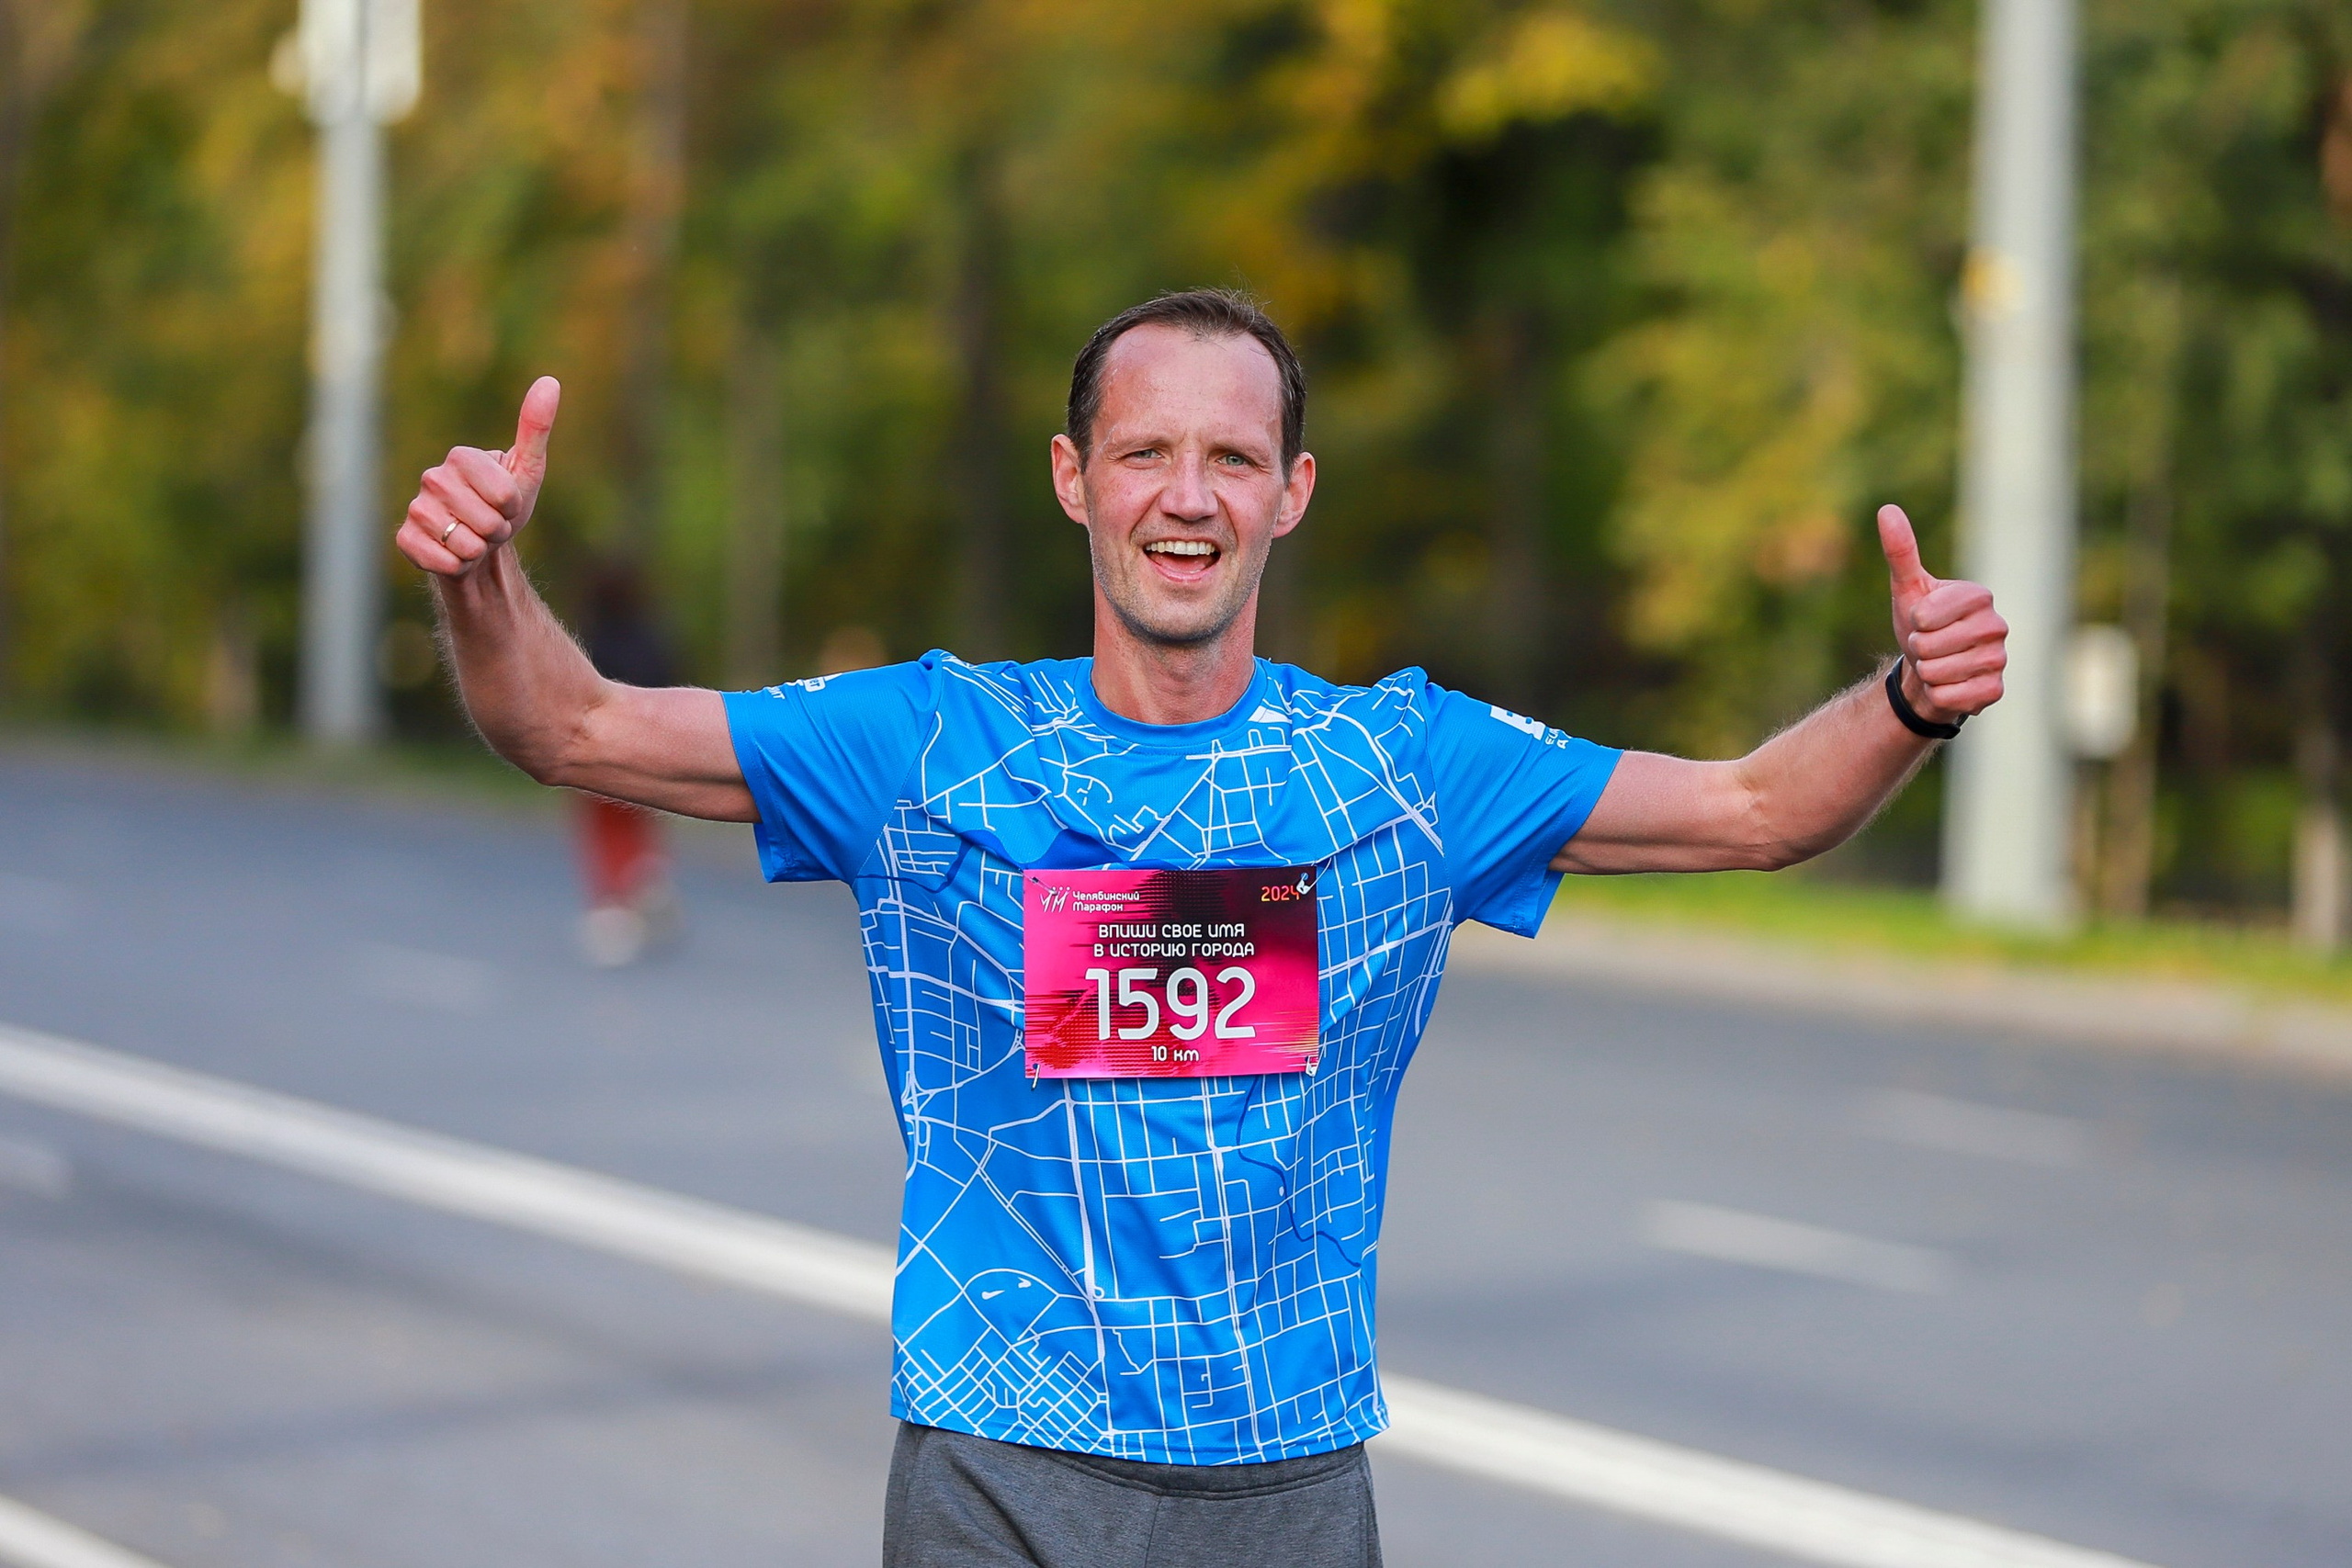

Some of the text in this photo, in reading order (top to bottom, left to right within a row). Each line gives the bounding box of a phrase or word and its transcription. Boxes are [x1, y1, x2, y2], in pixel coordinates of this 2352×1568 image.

[1072, 891, 1140, 901] Челябинский
[1261, 885, 1300, 902] 2024
[1072, 901, 1124, 913] Марафон
[1098, 923, 1245, 939] ВПИШИ СВОЕ ИМЯ
[1093, 942, 1255, 957] В ИСТОРИЮ ГОРОДА
[1085, 966, 1256, 1041] 1592
[1151, 1045, 1167, 1062] 10
